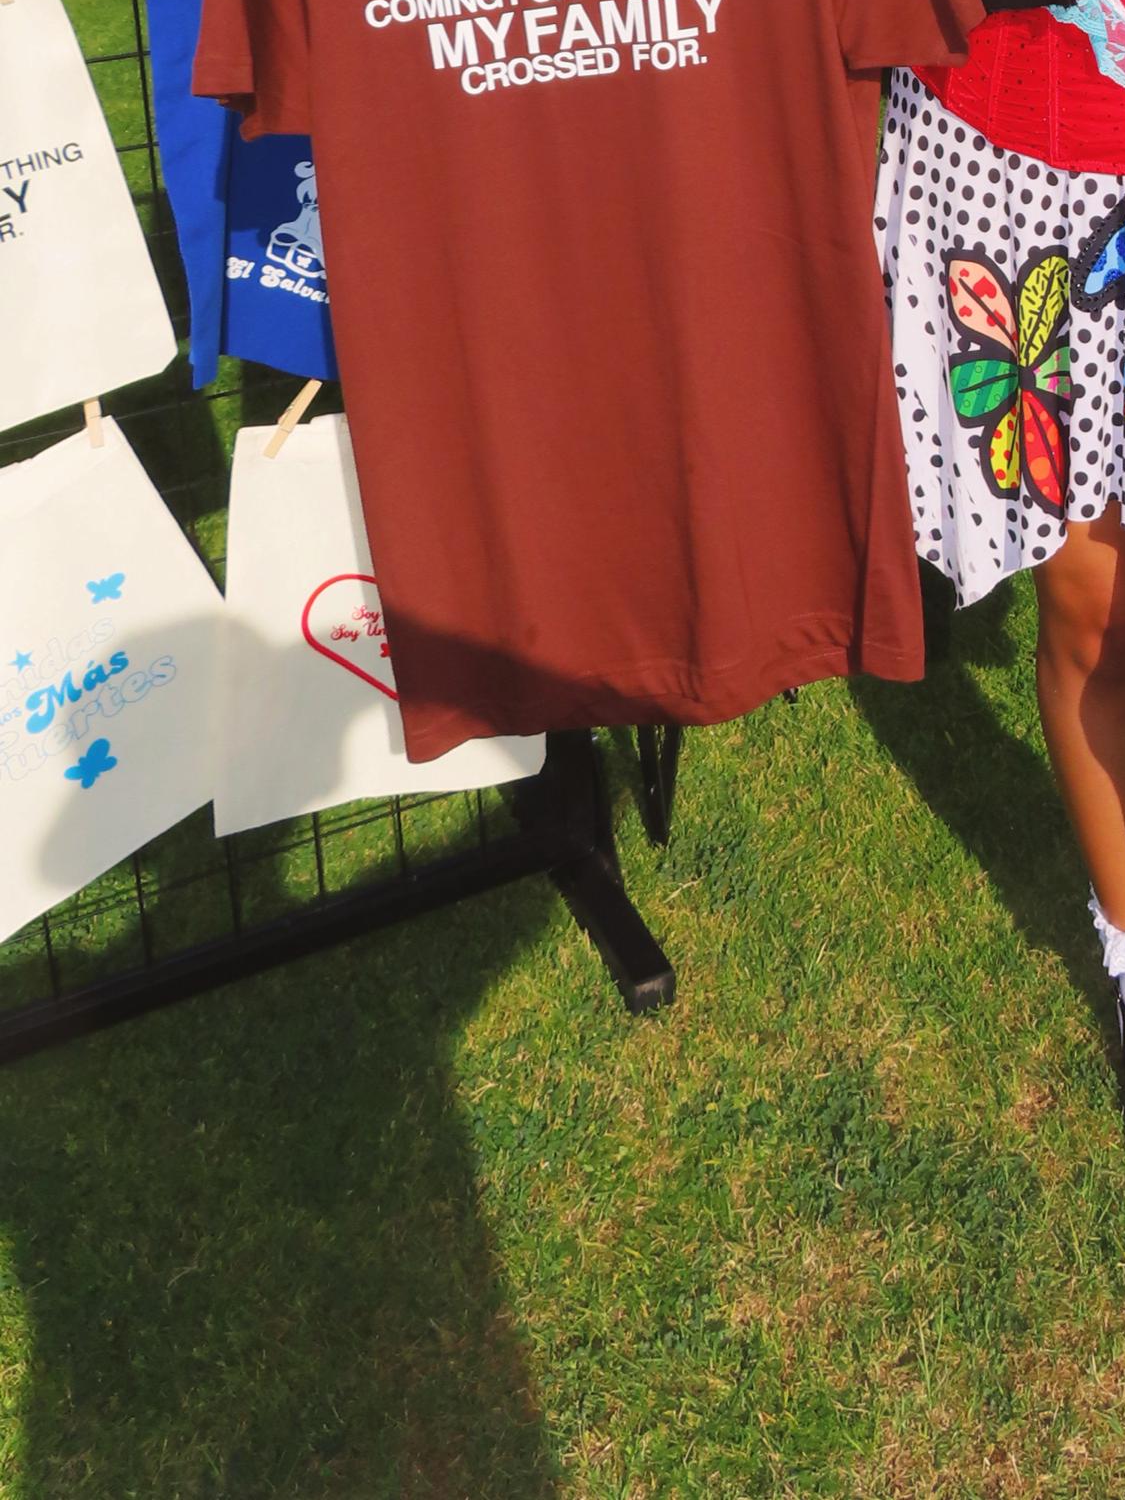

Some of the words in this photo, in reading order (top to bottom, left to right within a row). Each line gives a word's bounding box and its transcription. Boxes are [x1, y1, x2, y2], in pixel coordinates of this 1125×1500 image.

[427, 11, 515, 70] MY
[461, 46, 621, 95] CROSSED
[632, 37, 708, 72] FOR.
[0, 142, 84, 180] THING
[227, 256, 256, 279] El
[259, 264, 330, 304] Salva
[330, 623, 361, 642] Soy
[352, 604, 381, 623] Soy
[25, 650, 130, 735] Más
